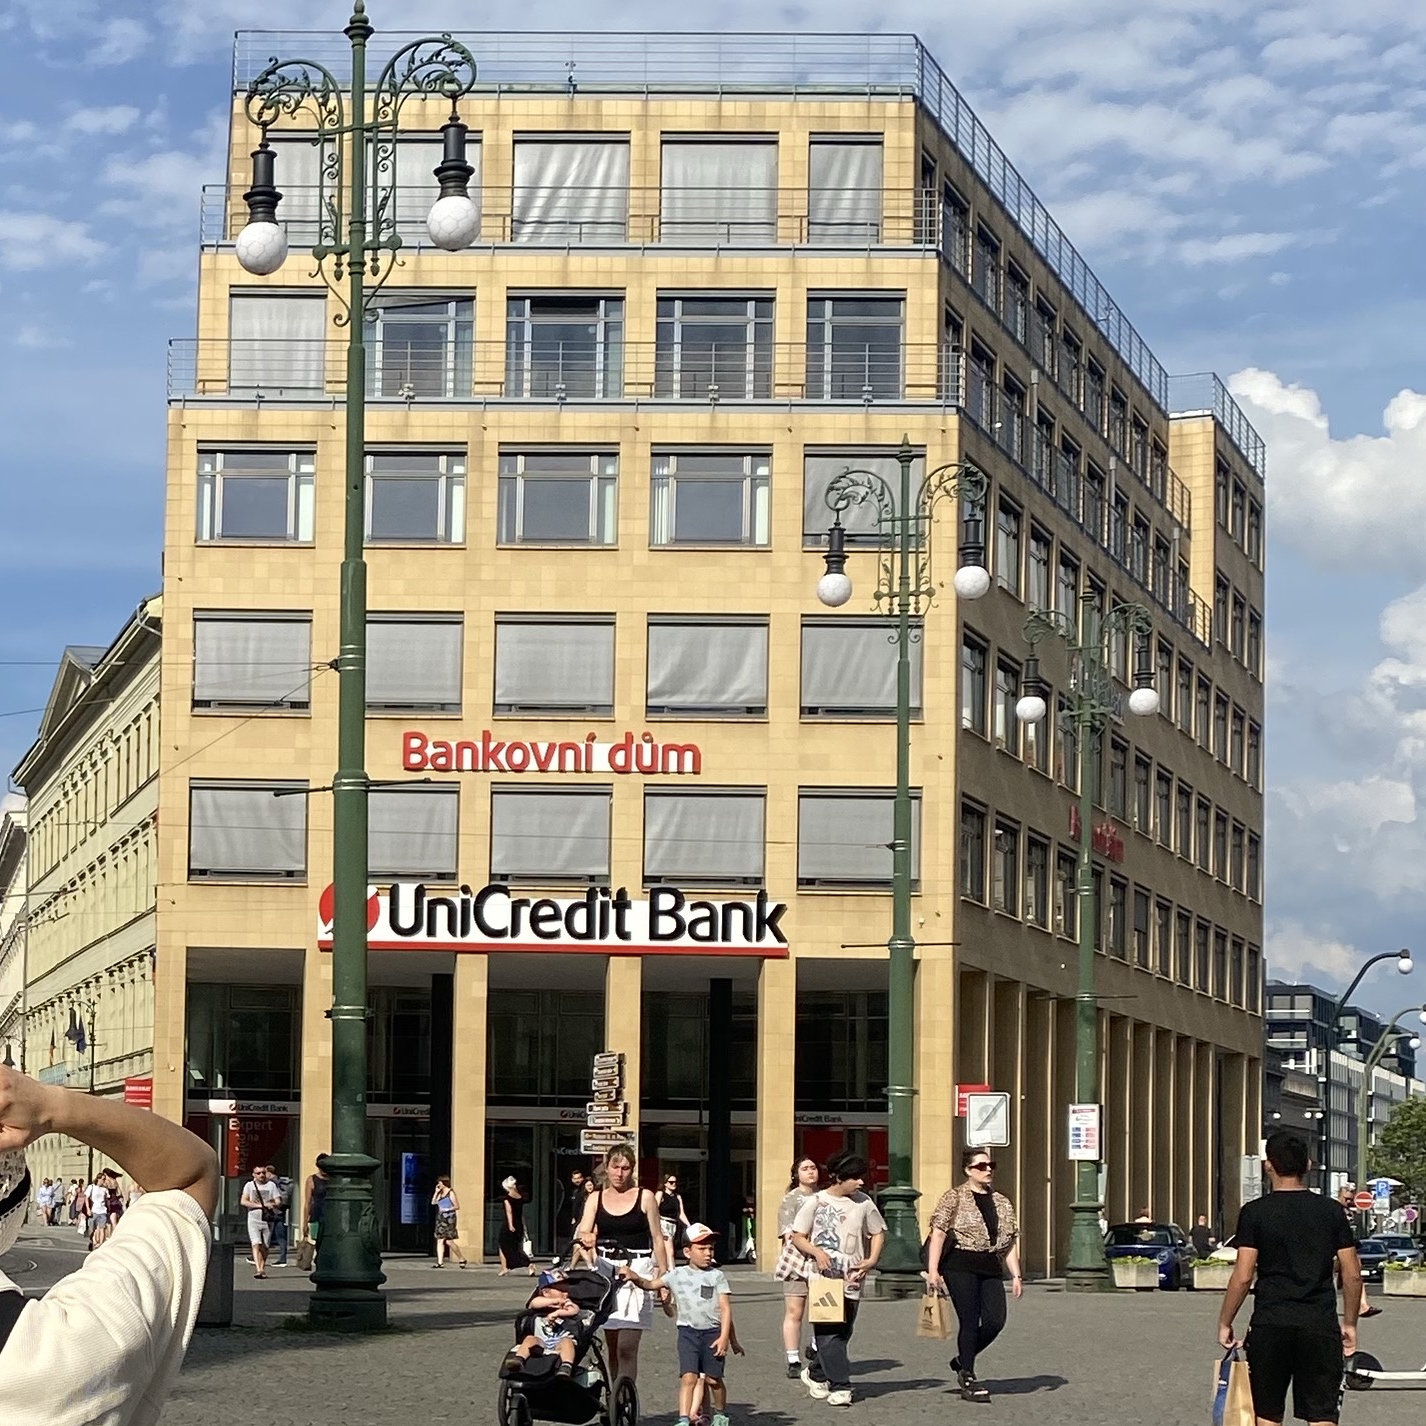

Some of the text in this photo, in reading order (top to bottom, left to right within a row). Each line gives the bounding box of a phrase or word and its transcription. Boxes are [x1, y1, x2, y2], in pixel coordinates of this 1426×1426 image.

[403, 730, 701, 774] Bankovní dům
[389, 884, 788, 943] UniCredit Bank
[238, 1103, 289, 1112] UniCredit Bank
[229, 1117, 273, 1132] Expert
